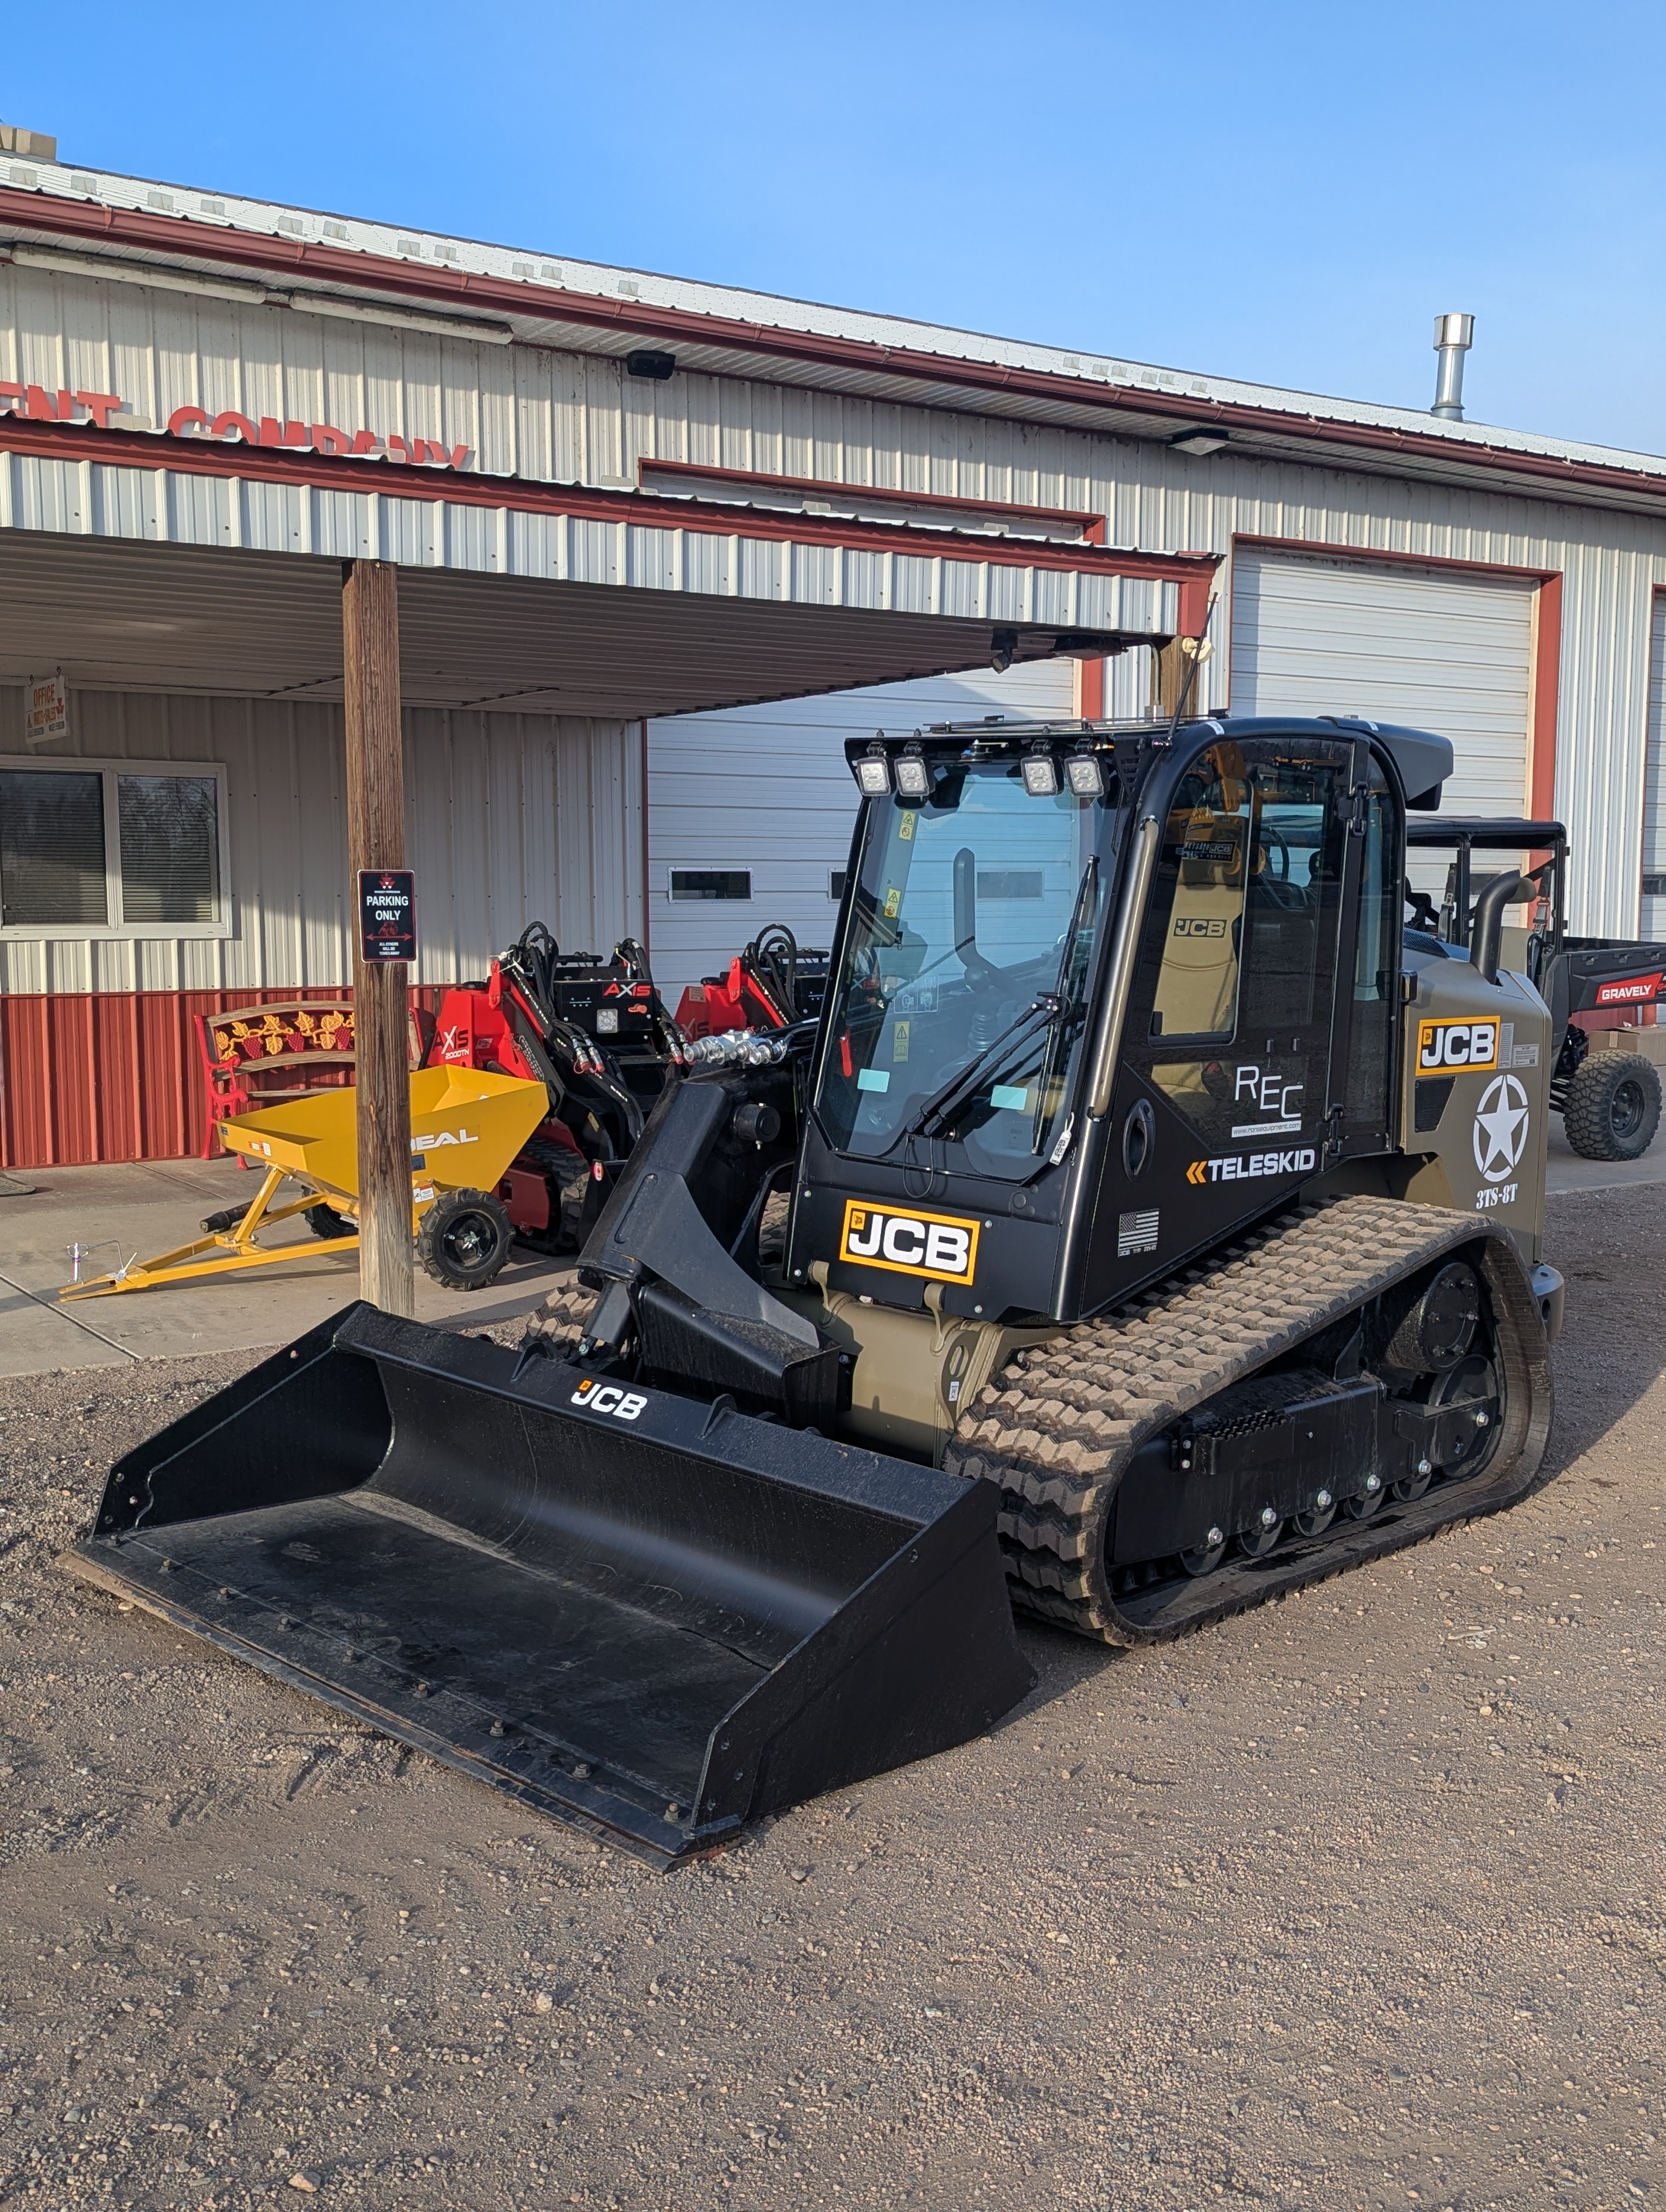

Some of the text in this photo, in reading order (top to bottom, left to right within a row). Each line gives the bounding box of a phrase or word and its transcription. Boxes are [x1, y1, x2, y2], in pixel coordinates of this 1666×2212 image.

[34, 684, 55, 707] OFFICE
[366, 896, 409, 906] PARKING
[375, 910, 401, 921] ONLY
[1176, 920, 1225, 936] JCB
[603, 982, 651, 998] AXIS
[1601, 984, 1652, 1001] GRAVELY
[433, 1025, 469, 1054] AXIS
[1421, 1025, 1495, 1066] JCB
[445, 1049, 470, 1060] 2000TN
[1235, 1066, 1303, 1118] REC
[1233, 1123, 1300, 1134] www.ronsequipment.com
[1208, 1149, 1315, 1182] TELESKID
[1476, 1183, 1518, 1210] 3TS-8T
[849, 1214, 969, 1272] JCB
[571, 1383, 648, 1420] JCB
